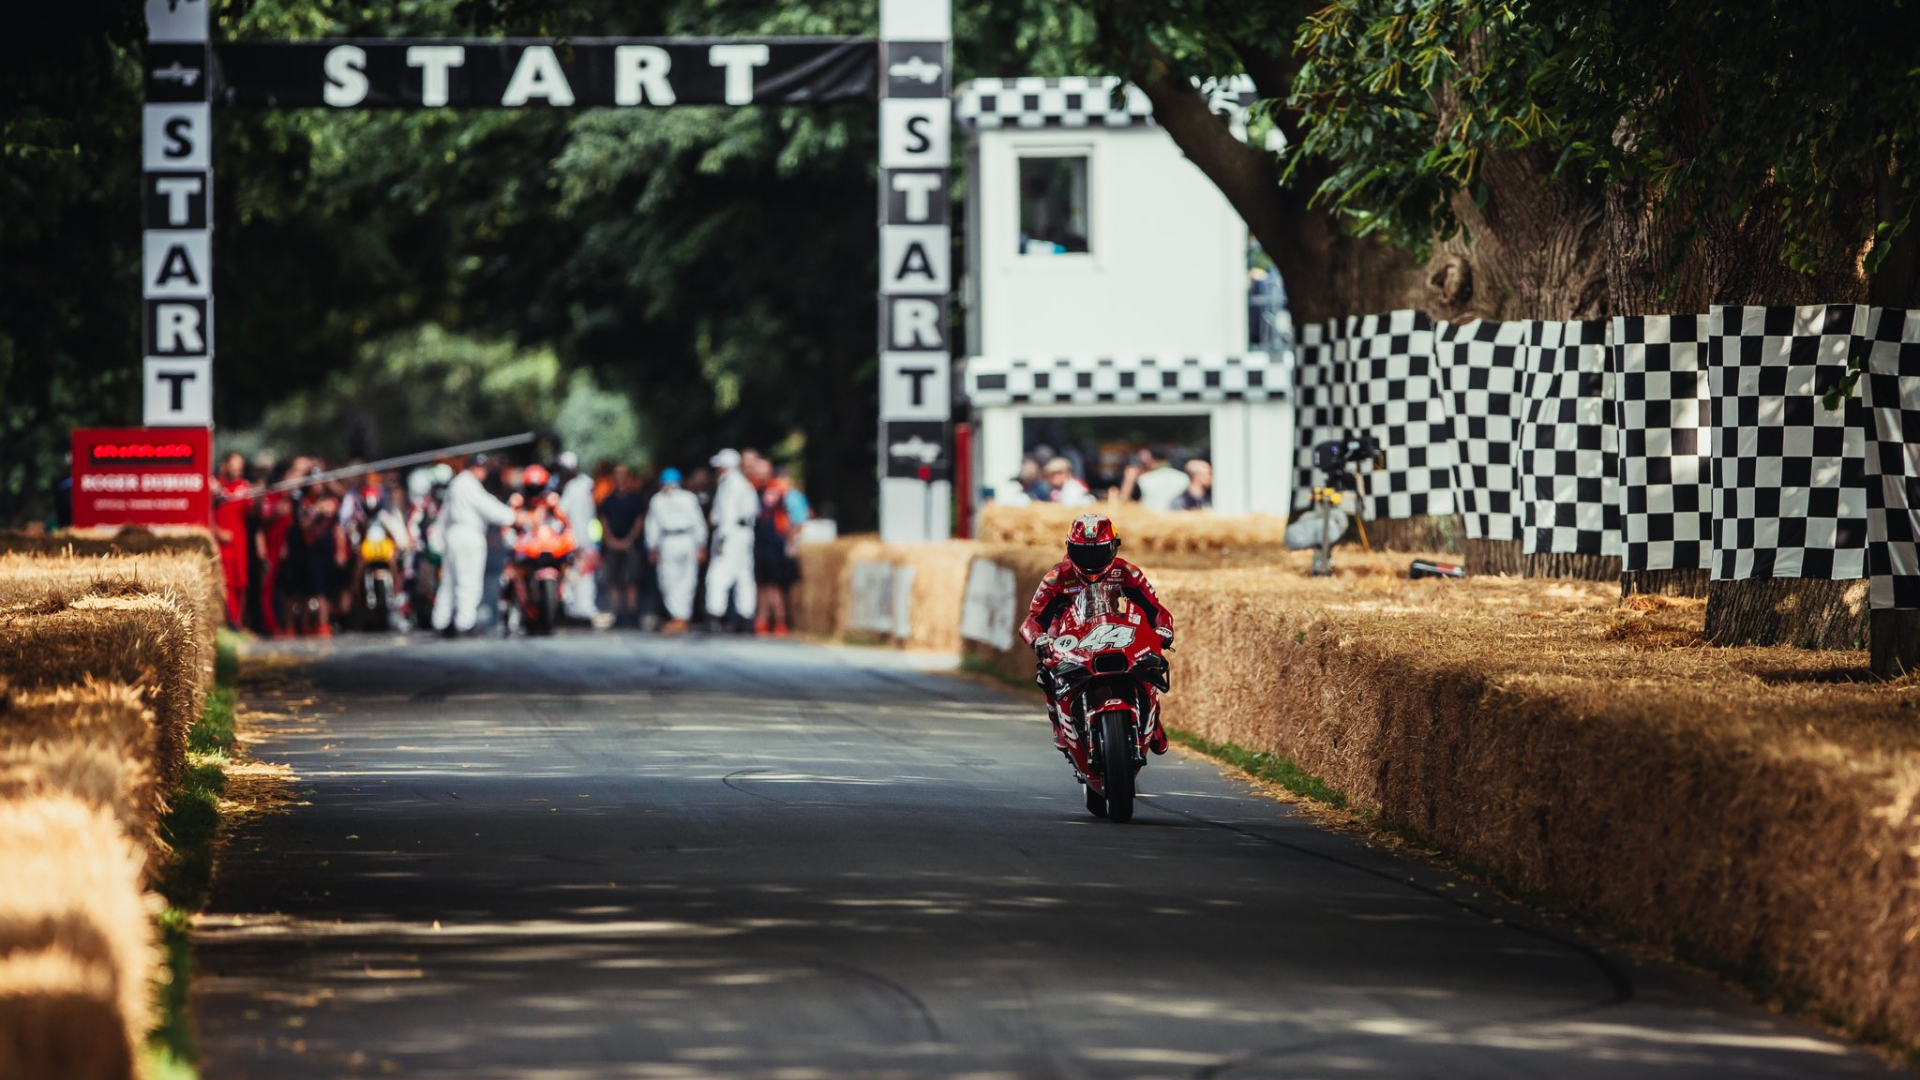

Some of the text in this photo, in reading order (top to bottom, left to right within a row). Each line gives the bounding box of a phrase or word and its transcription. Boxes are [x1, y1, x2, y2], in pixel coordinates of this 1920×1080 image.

[322, 43, 770, 107] START
[156, 116, 204, 411] START
[893, 115, 942, 406] START
[81, 474, 139, 492] ROGER
[1059, 639, 1072, 647] 49
[1078, 623, 1135, 651] 44
